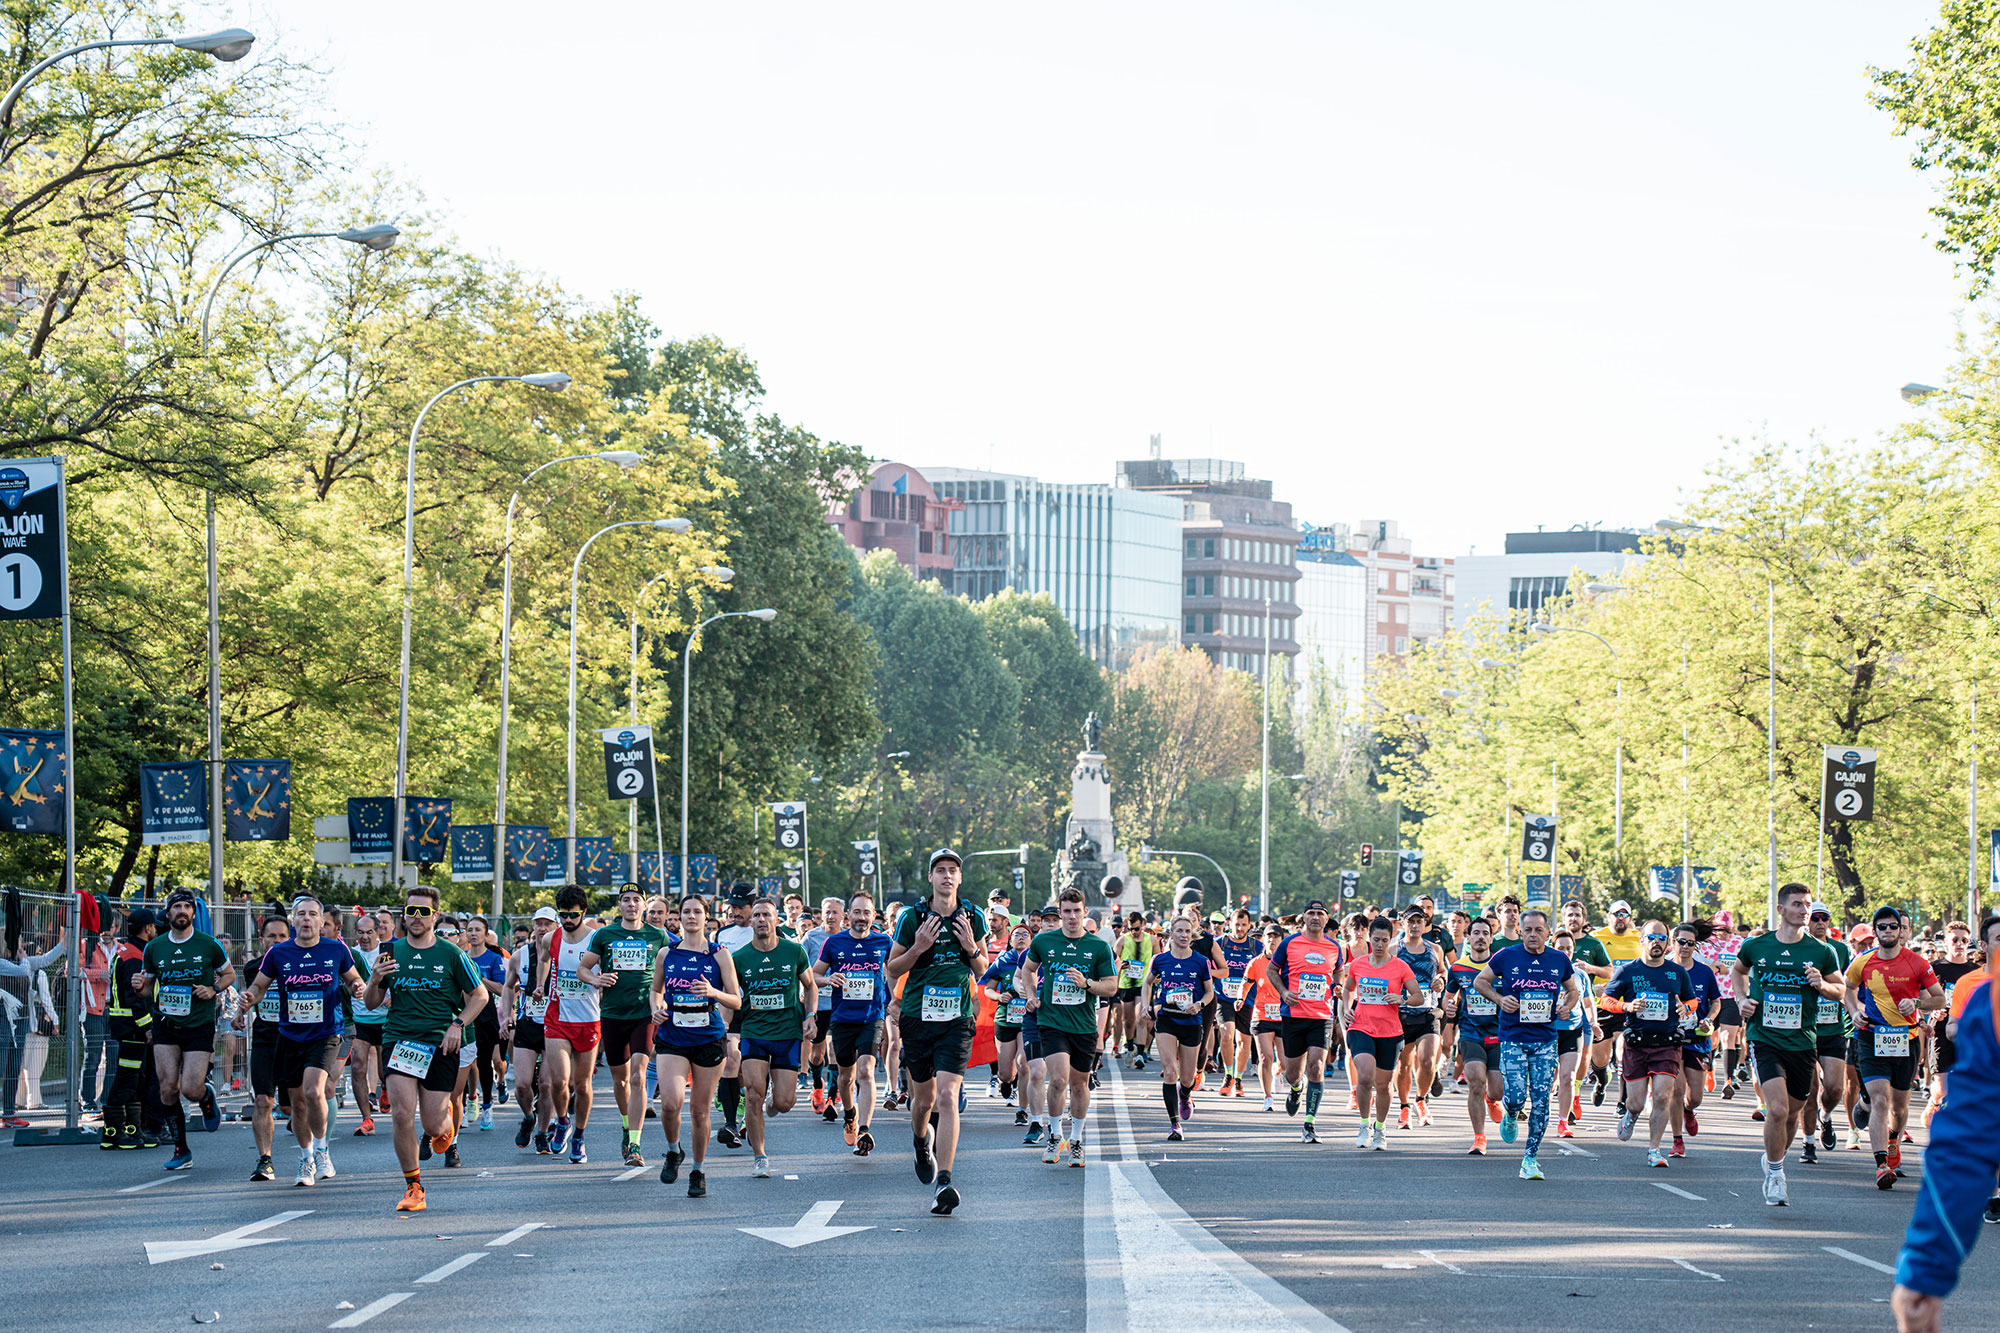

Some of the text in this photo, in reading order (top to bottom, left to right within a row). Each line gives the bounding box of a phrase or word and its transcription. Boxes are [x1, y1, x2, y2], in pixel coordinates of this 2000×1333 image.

[0, 512, 44, 536] AJÓN
[2, 536, 27, 548] WAVE
[5, 562, 22, 600] 1
[613, 750, 644, 763] CAJÓN
[624, 773, 637, 790] 2
[1835, 771, 1866, 783] CAJÓN
[1841, 793, 1855, 811] 2
[173, 806, 196, 814] MAYO
[146, 816, 204, 825] DÍA DE EUROPA
[786, 833, 794, 844] 3
[1534, 845, 1542, 856] 3
[839, 962, 880, 971] MADRID
[161, 969, 202, 980] MADRID
[284, 973, 333, 984] MADRID
[394, 977, 441, 988] MADRID
[562, 980, 582, 988] 21839
[749, 978, 790, 989] MADRID
[1305, 982, 1320, 990] 6094
[1511, 979, 1558, 989] MADRID
[1058, 985, 1080, 993] 31239
[1362, 986, 1382, 994] 35144
[164, 995, 184, 1004] 33581
[928, 999, 953, 1008] 33211
[1528, 1002, 1545, 1010] 8005
[1769, 1005, 1794, 1015] 34978
[1882, 1036, 1901, 1044] 8069
[410, 1041, 430, 1051] ZURICH
[399, 1048, 424, 1062] 26917
